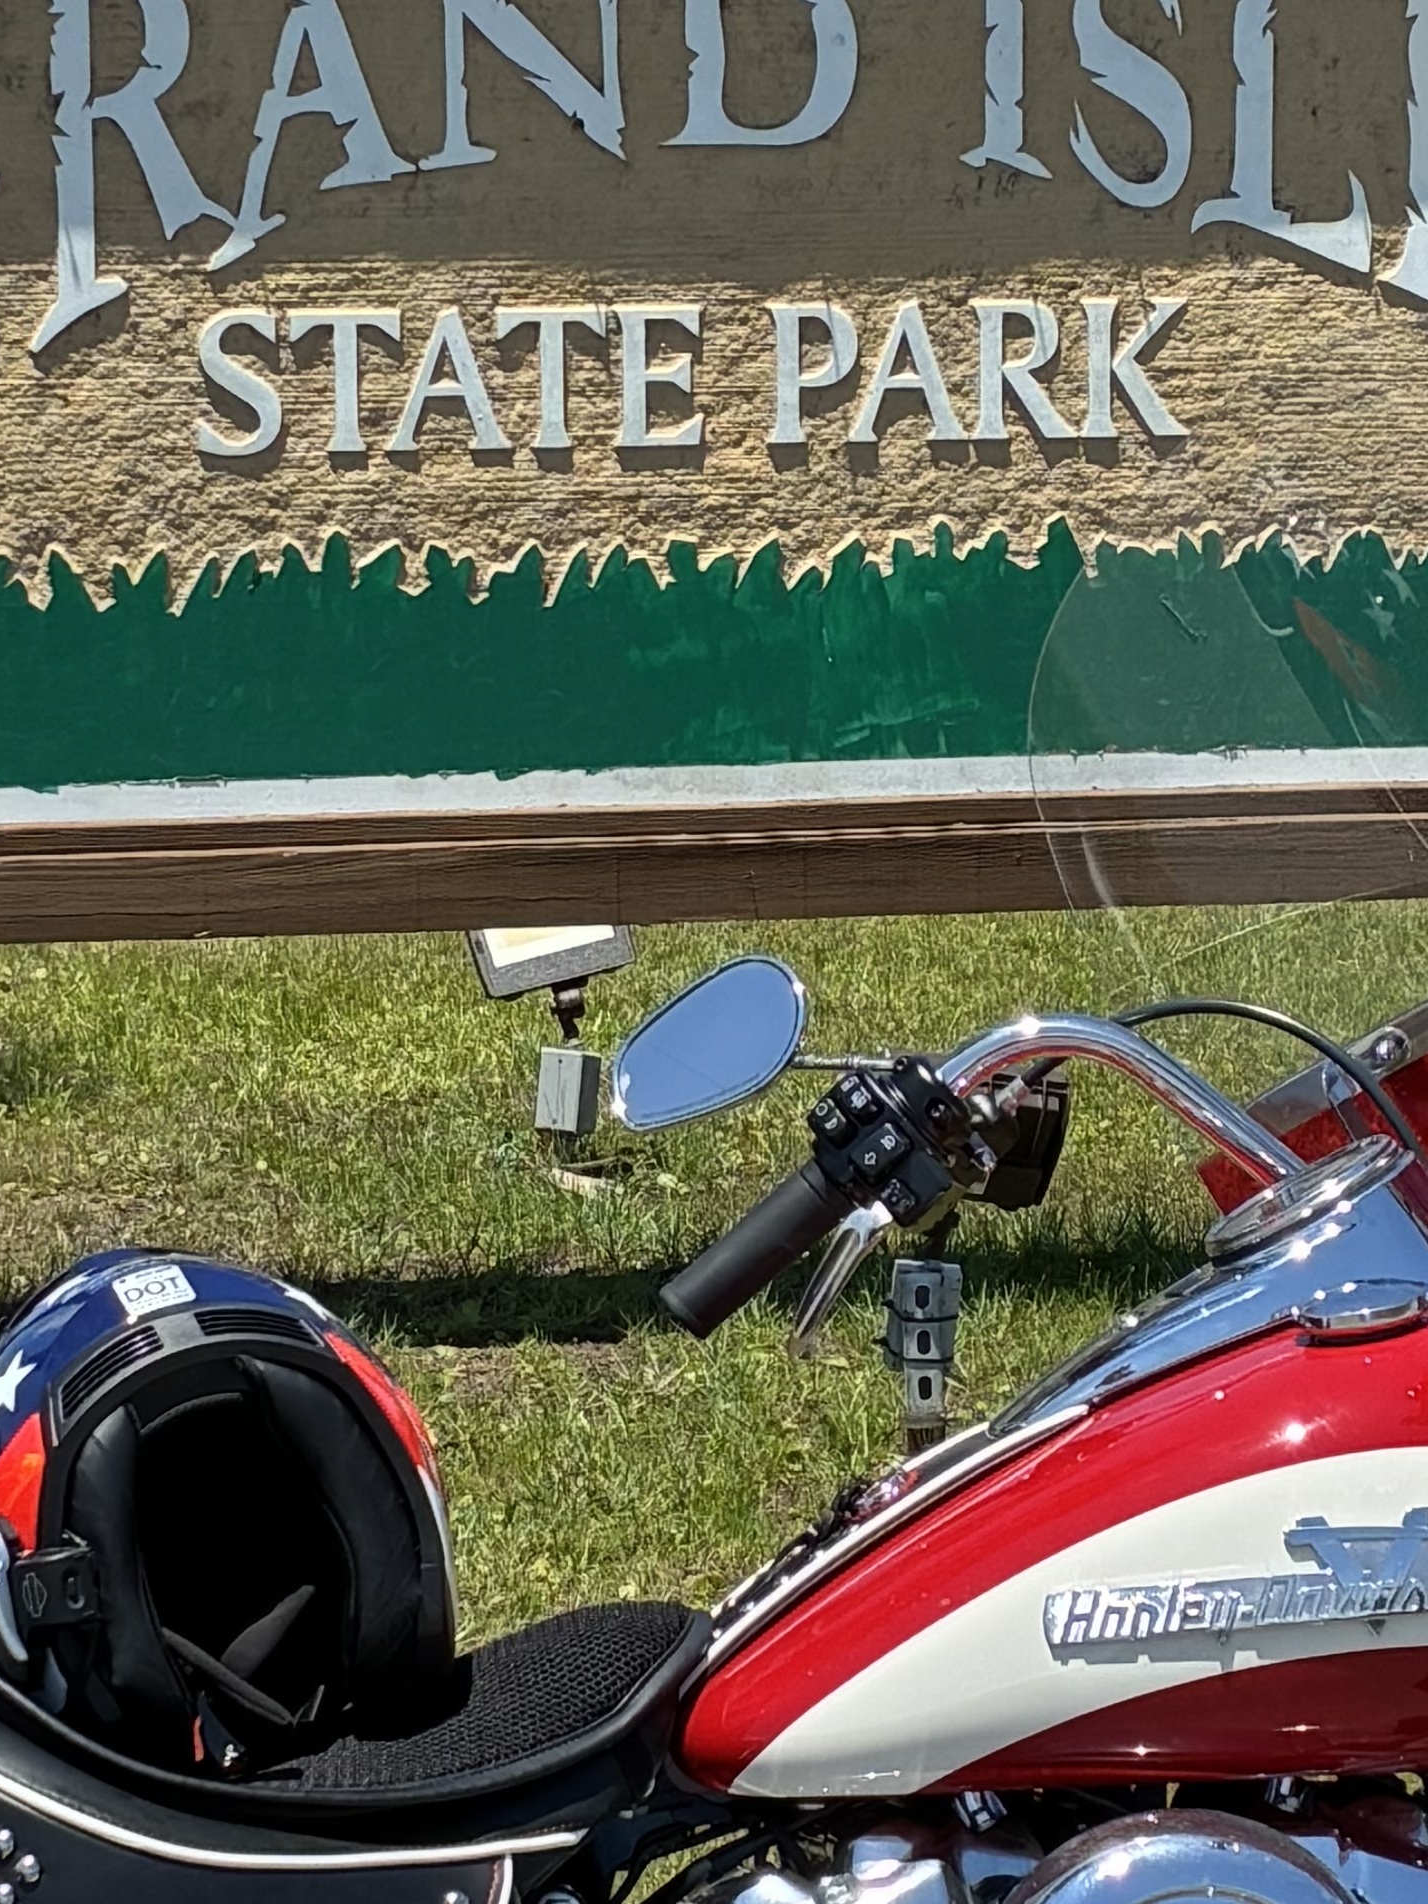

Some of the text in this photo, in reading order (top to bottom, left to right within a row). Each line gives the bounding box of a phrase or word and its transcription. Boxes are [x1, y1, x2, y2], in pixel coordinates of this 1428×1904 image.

[198, 297, 1191, 457] STATE PARK
[124, 1275, 179, 1303] DOT
